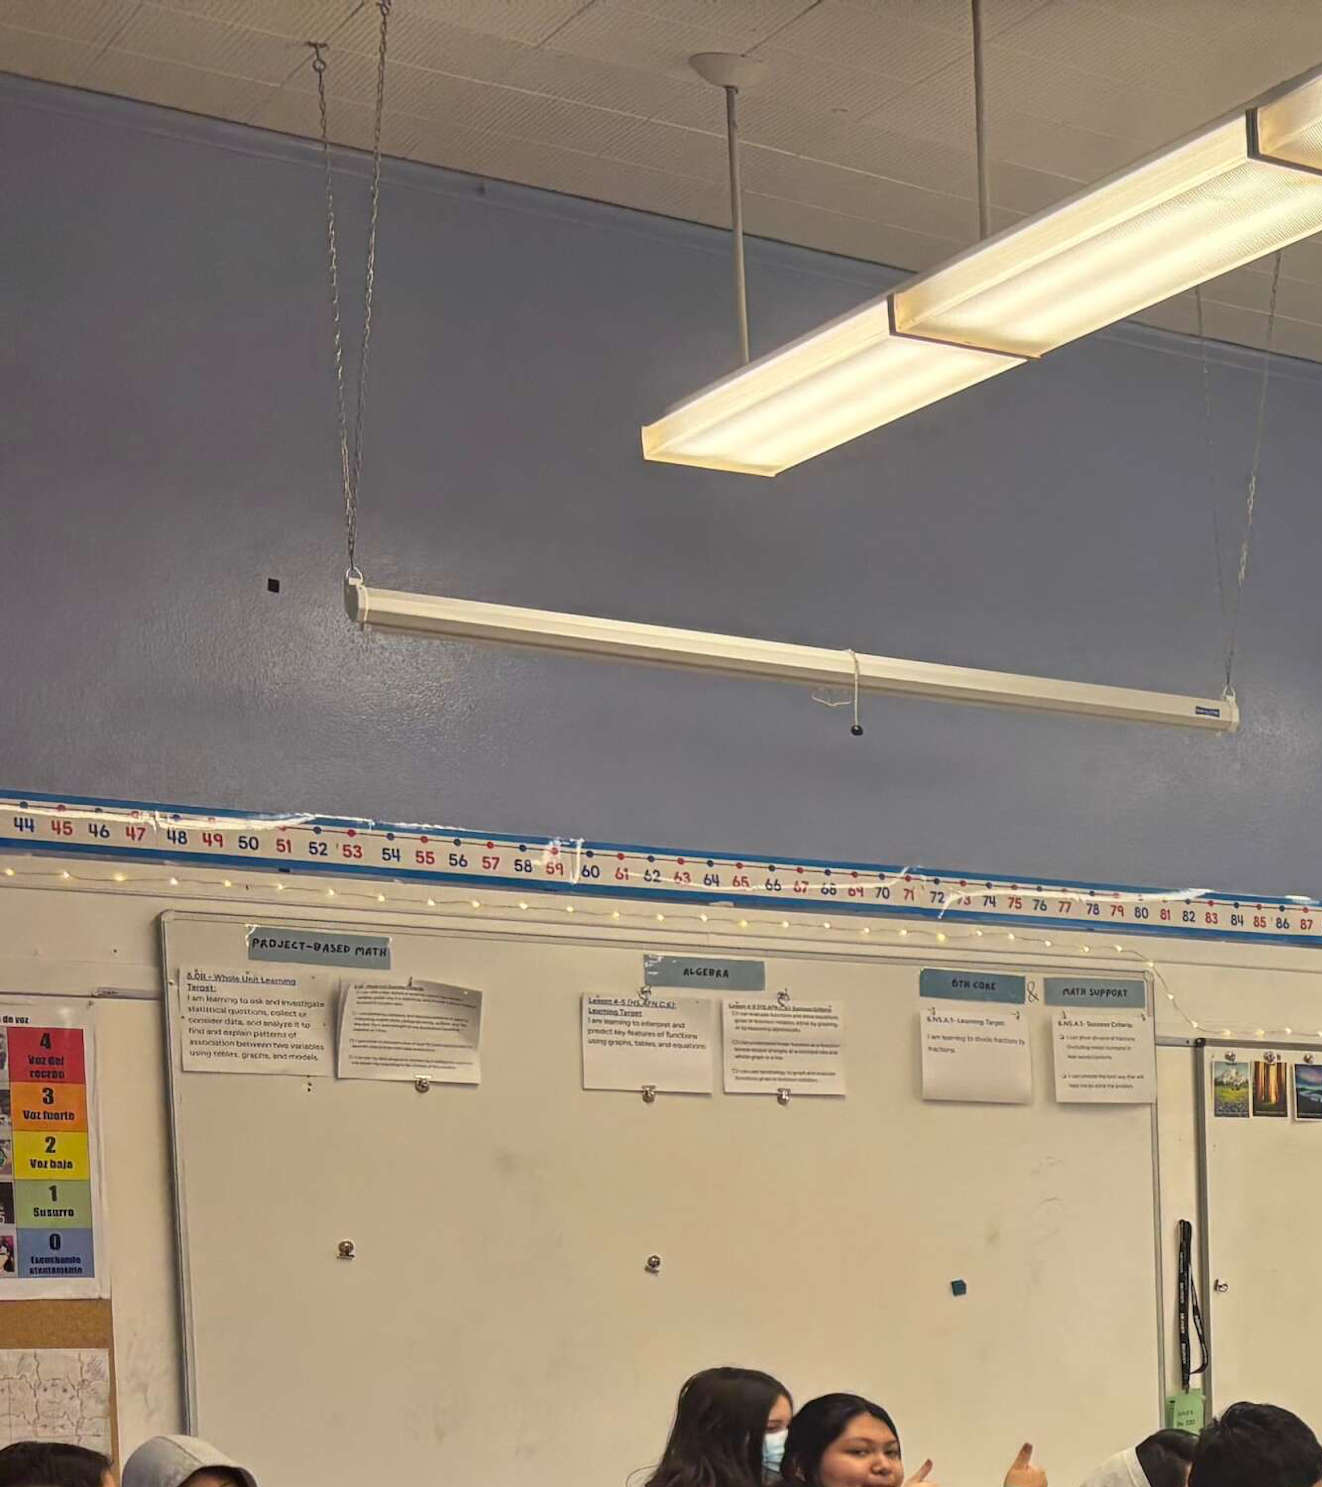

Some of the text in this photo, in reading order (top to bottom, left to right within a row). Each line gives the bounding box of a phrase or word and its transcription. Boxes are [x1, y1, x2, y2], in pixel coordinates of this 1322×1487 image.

[13, 816, 35, 833] 44
[51, 819, 73, 836] 45
[88, 822, 110, 839] 46
[125, 825, 146, 842] 47
[166, 827, 188, 845] 48
[202, 830, 224, 848] 49
[238, 835, 259, 851] 50
[275, 836, 292, 853] 51
[308, 841, 328, 856] 52
[342, 844, 363, 860] 53
[381, 847, 401, 863] 54
[415, 850, 435, 865] 55
[448, 853, 468, 868] 56
[481, 856, 500, 871] 57
[514, 858, 533, 874] 58
[581, 864, 600, 879] 60
[703, 873, 720, 888] 64
[875, 886, 890, 900] 70
[903, 888, 915, 901] 71
[929, 890, 945, 904] 72
[983, 894, 997, 908] 74
[1008, 896, 1023, 910] 75
[1032, 897, 1048, 912] 76
[1058, 899, 1072, 914] 77
[1086, 902, 1100, 916] 78
[1110, 904, 1125, 918] 79
[1134, 905, 1149, 920] 80
[1160, 907, 1171, 921] 81
[1182, 908, 1196, 923] 82
[1205, 910, 1219, 925] 83
[1230, 912, 1244, 927] 84
[1253, 914, 1267, 929] 85
[1275, 916, 1290, 930] 86
[1299, 917, 1313, 931] 87
[252, 938, 387, 957] PROJECT-BASED MATH
[683, 967, 729, 978] ALGEBRA
[973, 981, 997, 991] CORE
[1063, 987, 1128, 999] MATH SUPPORT
[40, 1032, 51, 1049] 4
[42, 1087, 54, 1105] 3
[23, 1110, 41, 1121] Voz
[45, 1136, 56, 1154] 2
[30, 1158, 47, 1169] Voz
[49, 1185, 57, 1202] 1
[33, 1207, 75, 1217] Susurro
[50, 1233, 61, 1250] 0
